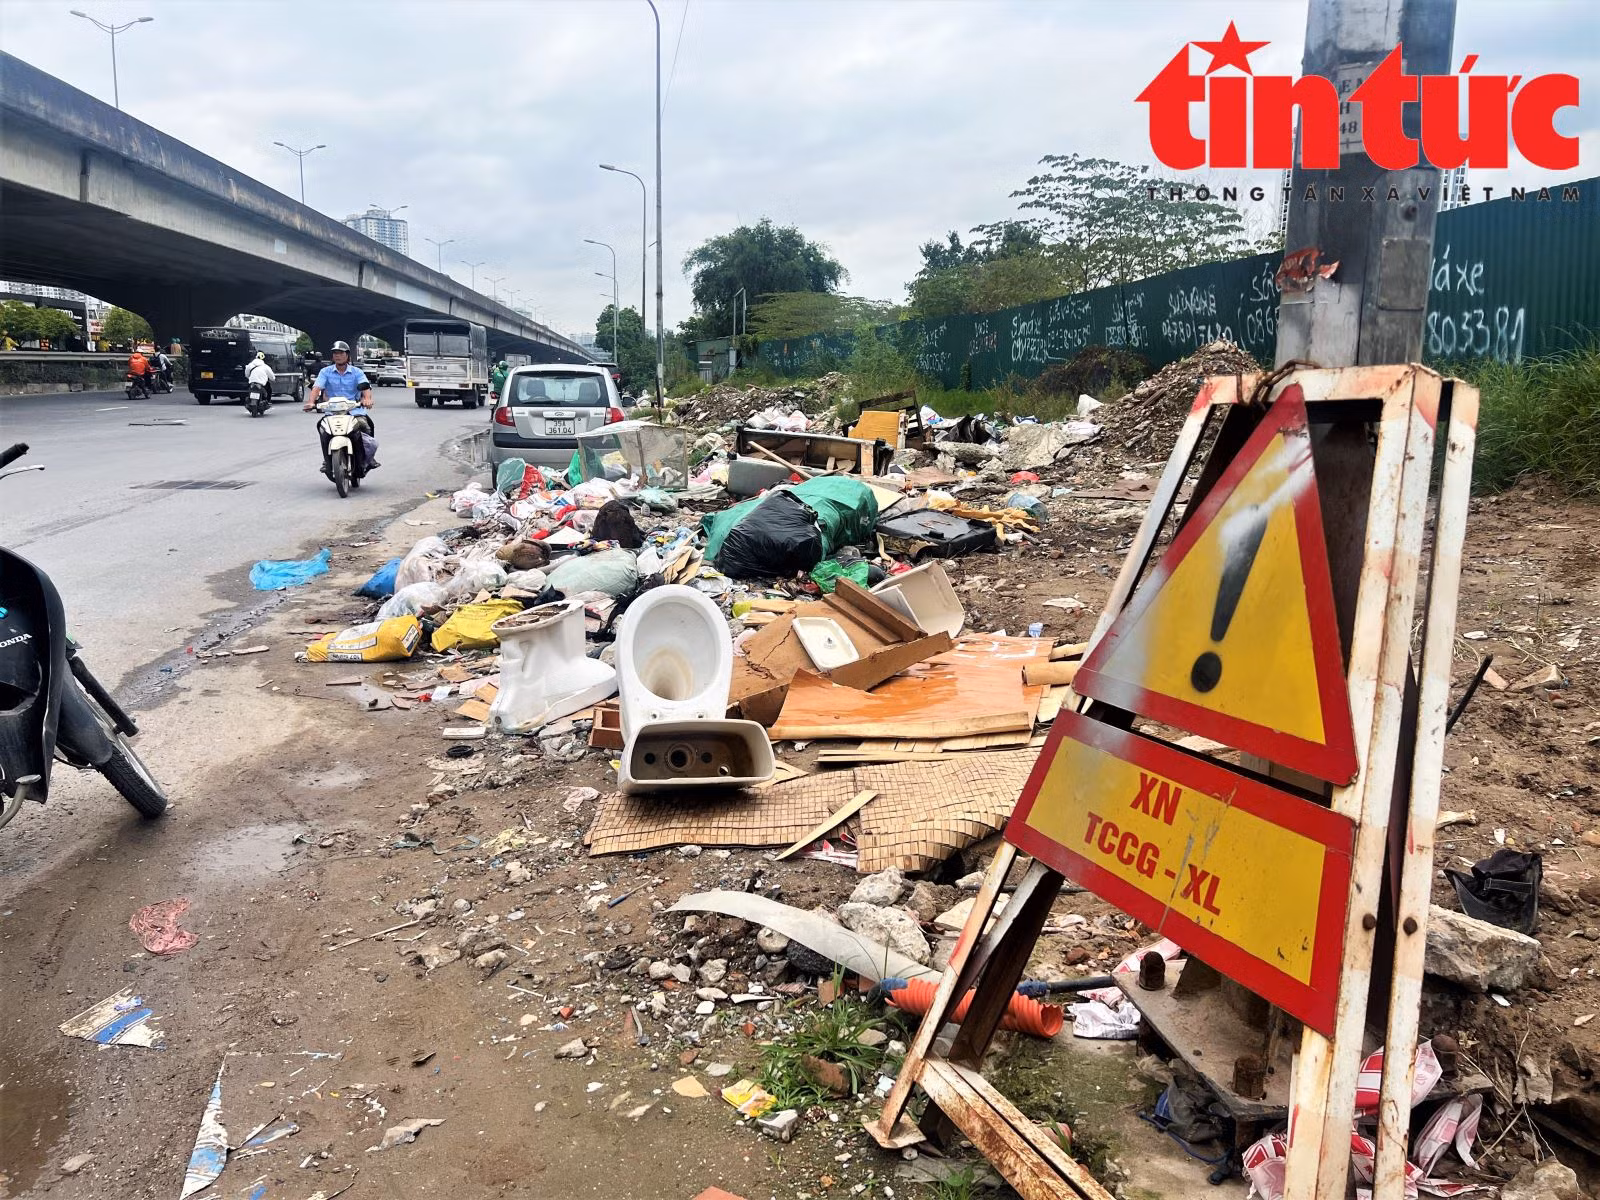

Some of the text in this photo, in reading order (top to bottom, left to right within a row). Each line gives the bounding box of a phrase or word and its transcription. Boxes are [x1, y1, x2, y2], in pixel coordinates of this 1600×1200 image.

[0, 633, 32, 648] ONDA
[1129, 772, 1183, 826] XN
[1083, 811, 1161, 880] TCCG
[1180, 863, 1222, 916] XL
